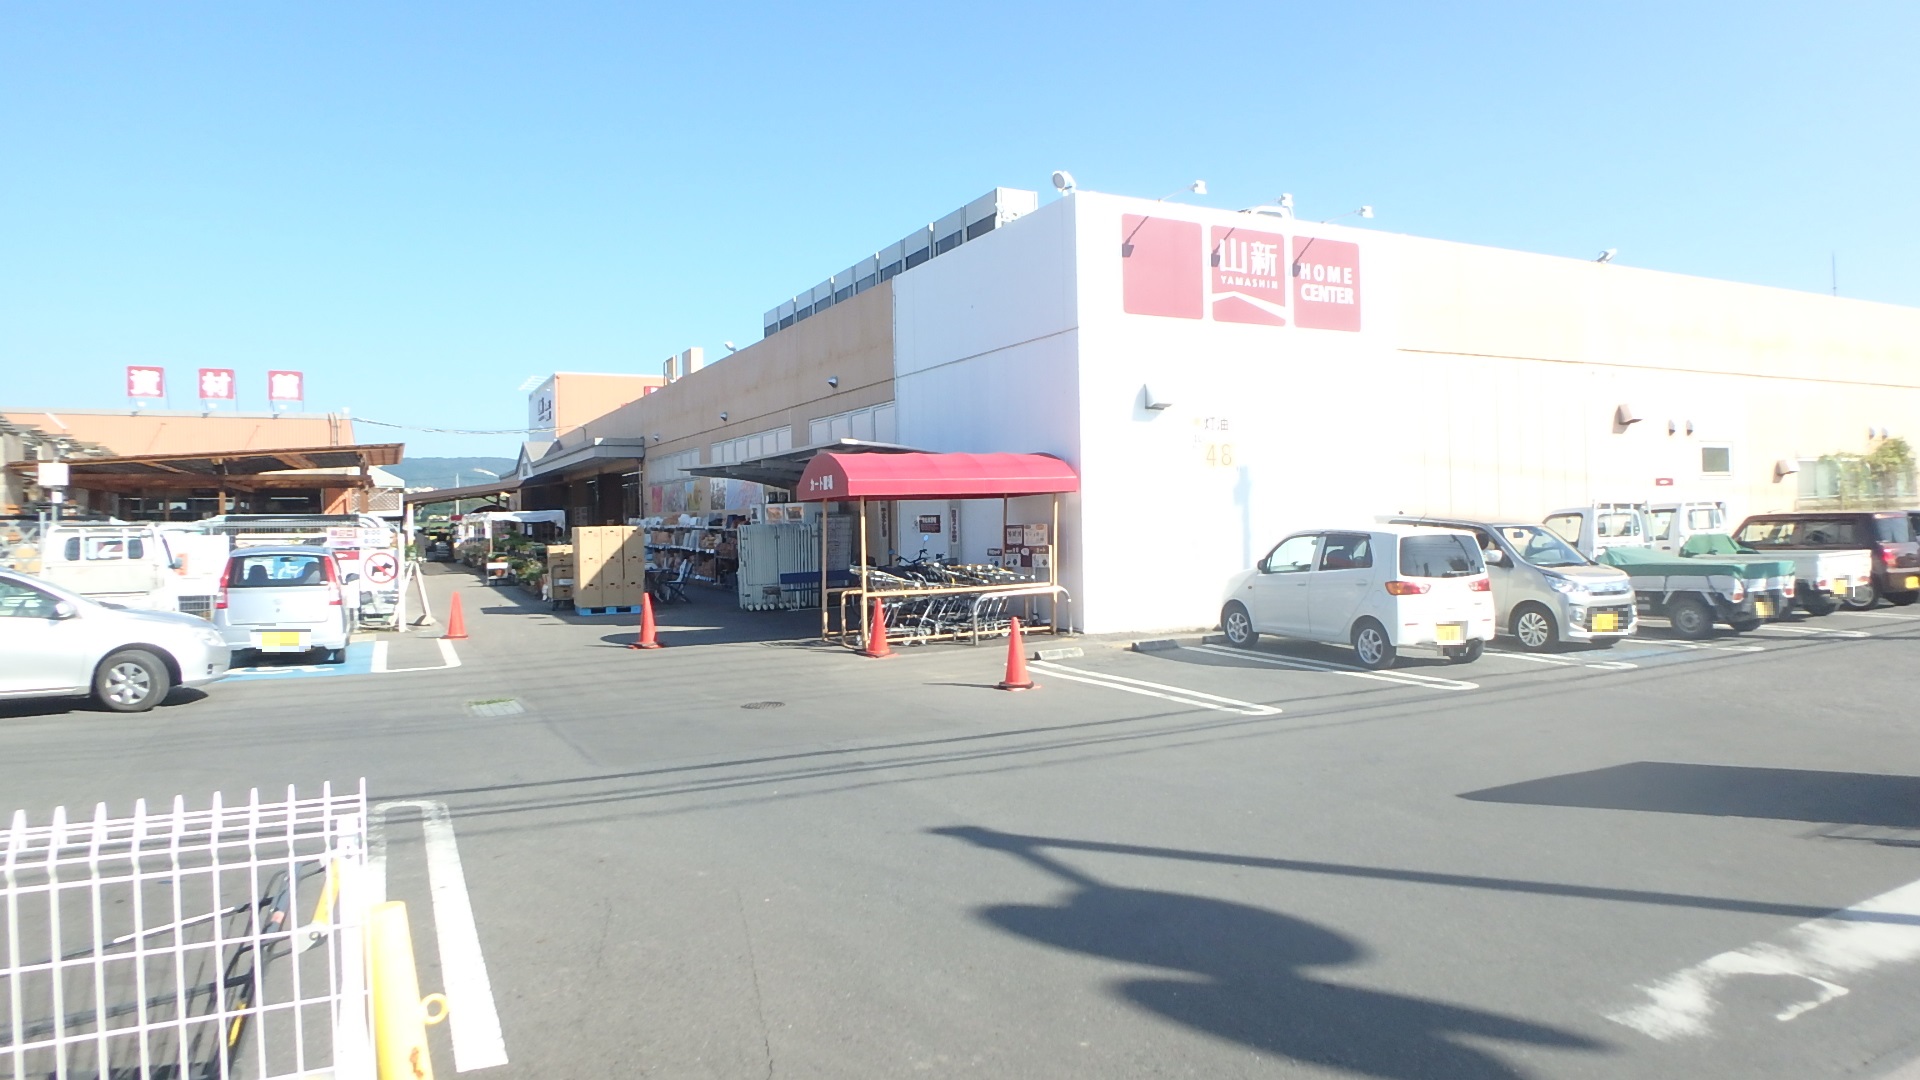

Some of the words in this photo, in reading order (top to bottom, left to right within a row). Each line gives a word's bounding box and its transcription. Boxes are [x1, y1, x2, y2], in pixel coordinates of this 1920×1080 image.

[1219, 238, 1278, 277] 山新
[1220, 275, 1278, 290] YAMASHIN
[1300, 262, 1352, 285] HOME
[1300, 284, 1354, 304] CENTER
